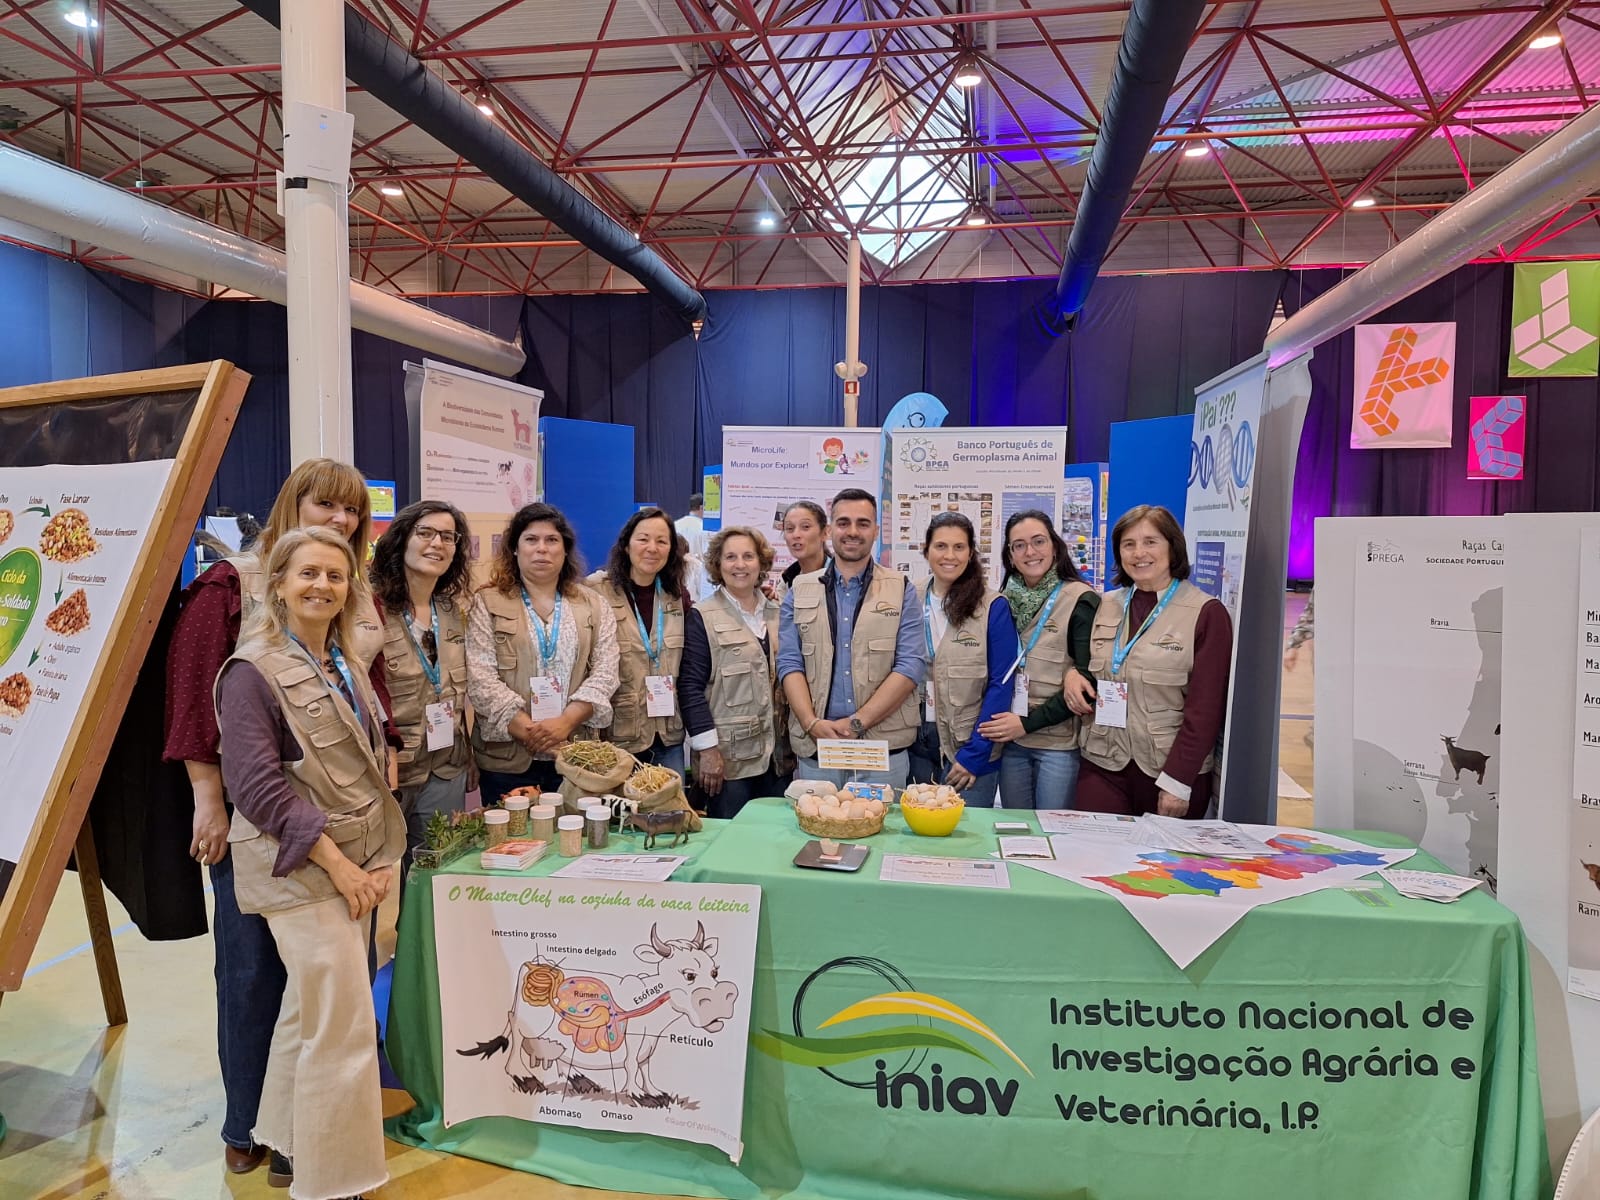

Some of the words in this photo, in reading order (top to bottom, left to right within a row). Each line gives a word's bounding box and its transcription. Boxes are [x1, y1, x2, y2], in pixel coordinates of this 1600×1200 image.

[1219, 390, 1236, 424] ???
[957, 440, 986, 449] Banco
[989, 440, 1038, 452] Português
[1042, 440, 1053, 448] de
[730, 460, 759, 469] Mundos
[761, 462, 773, 471] por
[775, 462, 808, 472] Explorar!
[952, 454, 1020, 466] Germoplasma
[1022, 453, 1057, 462] Animal
[60, 493, 72, 504] Fase
[72, 493, 90, 504] Larvar
[1462, 540, 1486, 553] Raças
[1368, 552, 1404, 563] SPREGA
[449, 886, 460, 901] O
[466, 886, 552, 906] MasterChef
[558, 893, 576, 904] na
[581, 890, 631, 909] cozinha
[638, 894, 656, 908] da
[661, 898, 692, 912] vaca
[698, 898, 750, 914] leiteira
[491, 929, 528, 938] Intestino
[528, 931, 557, 940] grosso
[546, 945, 582, 955] Intestino
[584, 947, 616, 957] delgado
[633, 981, 664, 1005] Esófago
[1050, 997, 1225, 1030] Instituto
[1239, 998, 1409, 1031] Nacional
[1422, 1000, 1474, 1031] de
[670, 1034, 714, 1048] Retículo
[1052, 1043, 1290, 1082] Investigação
[1301, 1044, 1438, 1082] Agrária
[1452, 1055, 1476, 1079] e
[875, 1059, 1020, 1118] iniav
[539, 1106, 582, 1119] Abomaso
[601, 1110, 633, 1121] Omaso
[1054, 1094, 1270, 1135] Veterinária,
[1281, 1102, 1320, 1130] I.P.
